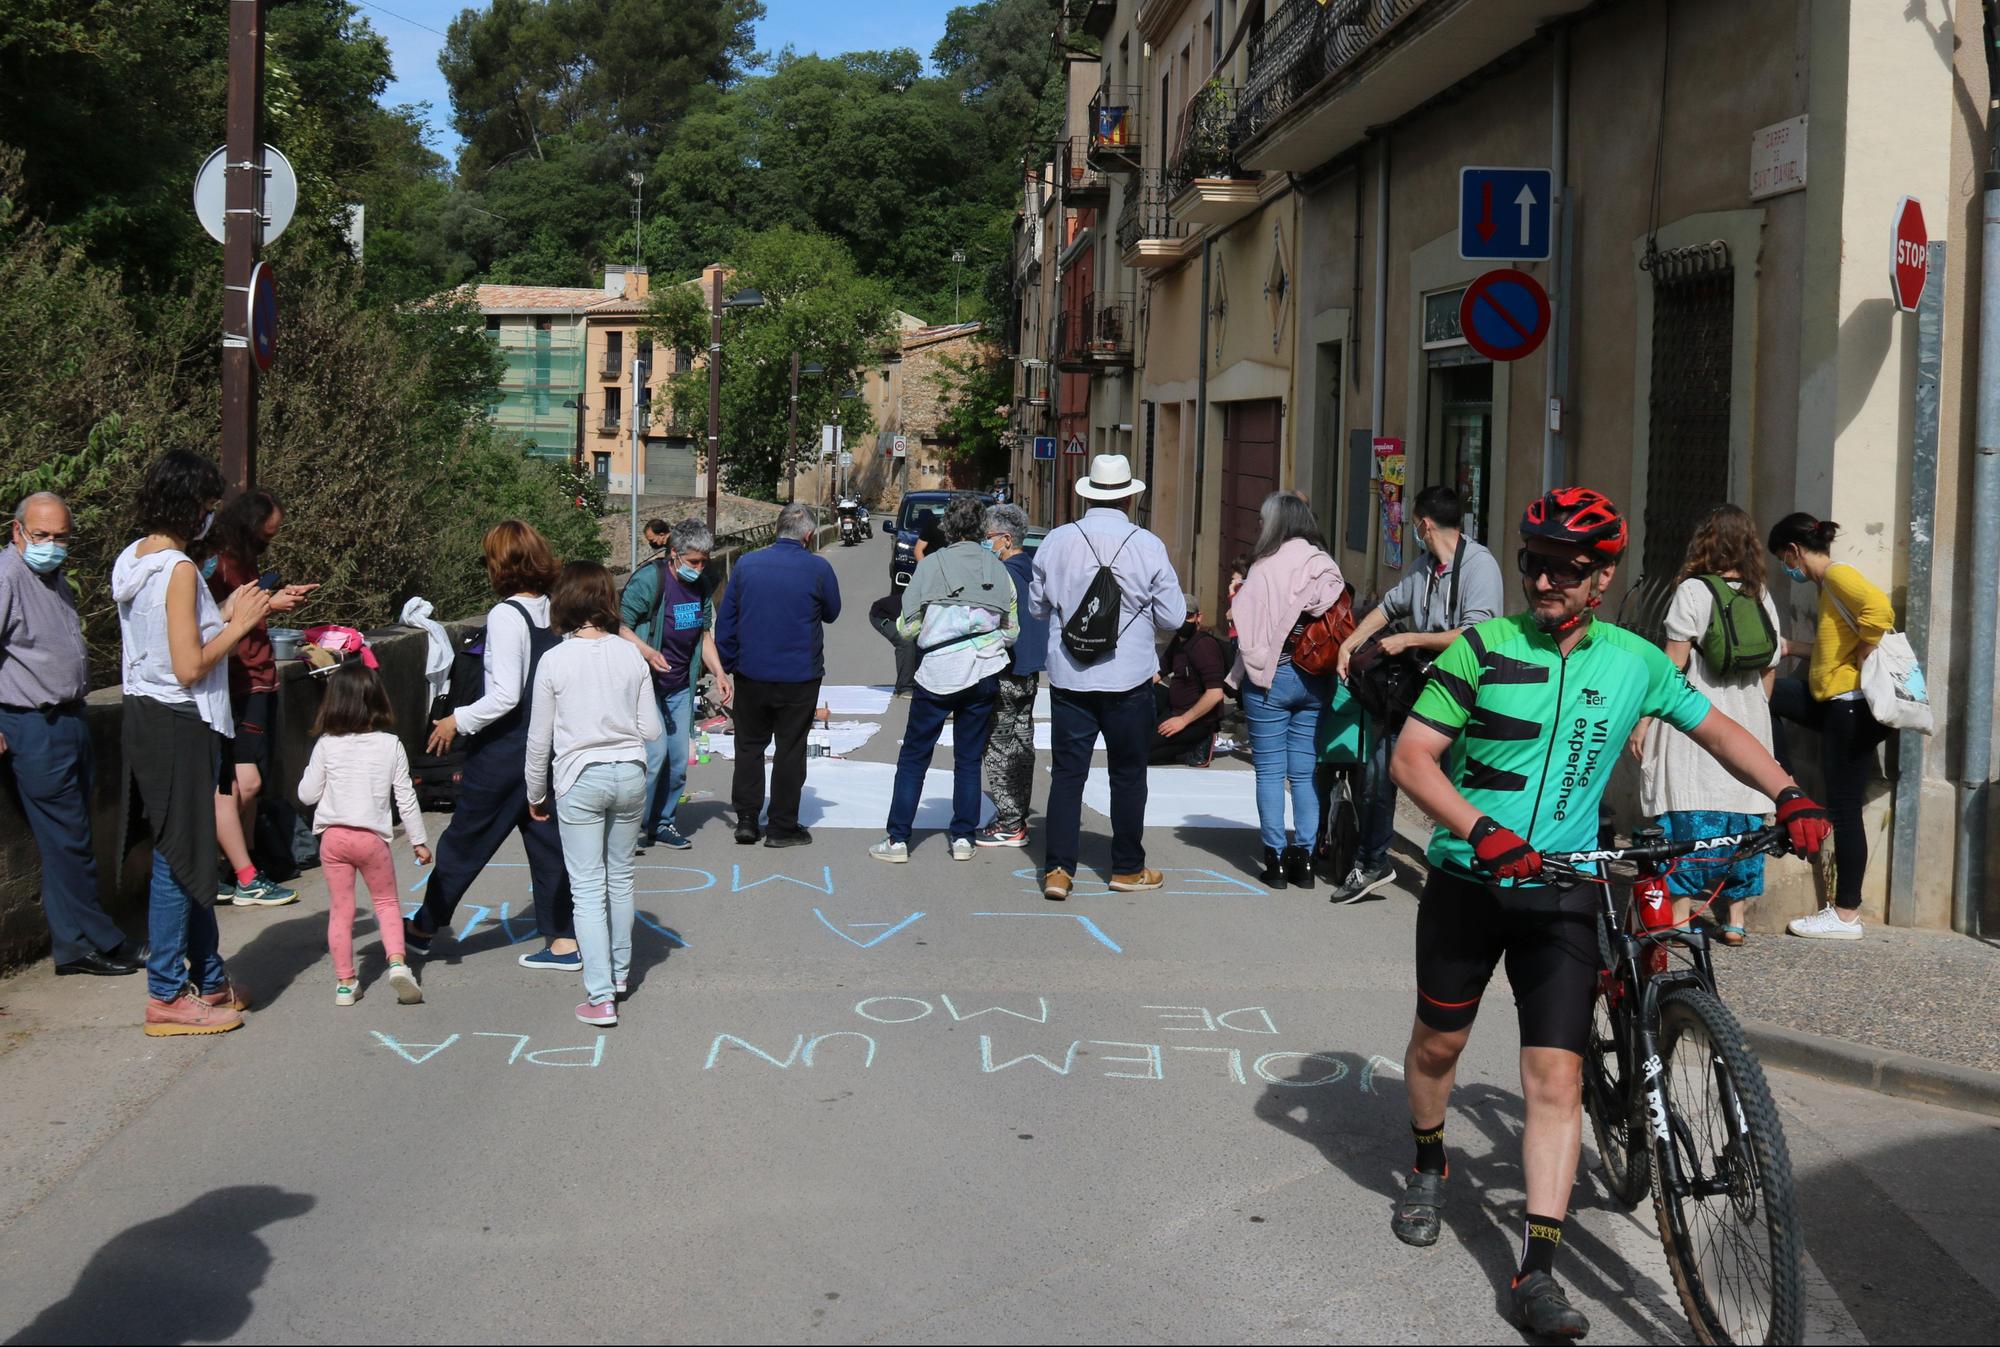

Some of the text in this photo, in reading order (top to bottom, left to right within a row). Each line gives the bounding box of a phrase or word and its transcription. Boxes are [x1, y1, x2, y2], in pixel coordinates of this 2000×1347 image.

[1897, 239, 1926, 268] STOP
[1591, 718, 1608, 745] VII
[1553, 718, 1588, 822] experience
[1577, 747, 1601, 788] bike
[855, 993, 1280, 1034] DE MO
[369, 1030, 606, 1068] PLA
[704, 1031, 876, 1070] UN
